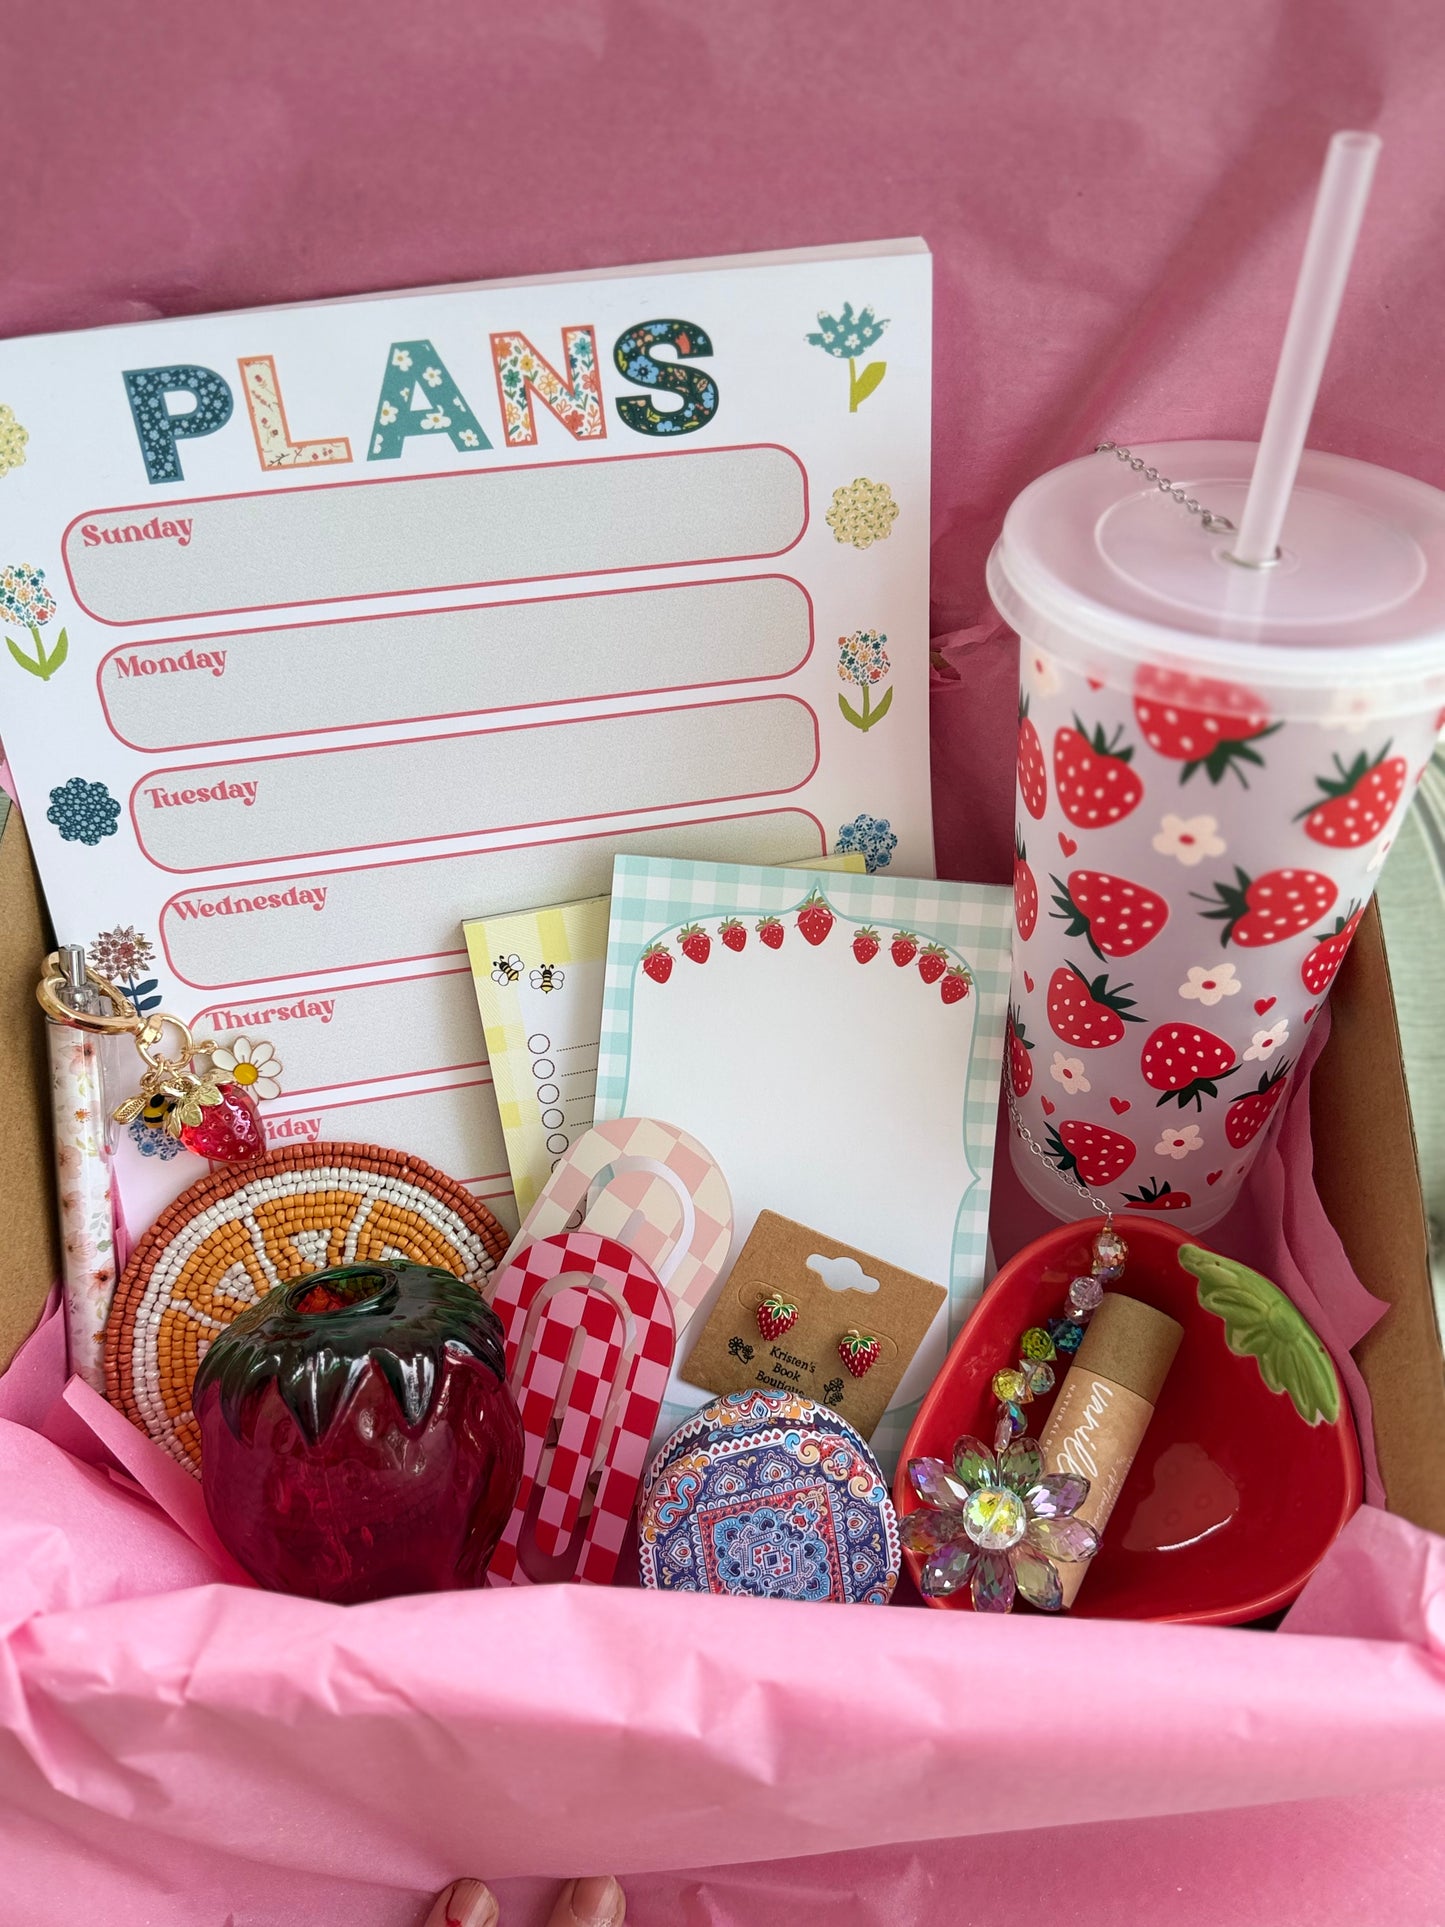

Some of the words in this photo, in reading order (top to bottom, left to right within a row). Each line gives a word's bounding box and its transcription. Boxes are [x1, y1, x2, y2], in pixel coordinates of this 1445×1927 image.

[122, 319, 719, 484] PLANS
[81, 517, 193, 547] Sunday
[114, 649, 227, 678] Monday
[144, 780, 258, 809] Tuesday
[171, 887, 328, 921] Wednesday
[205, 999, 335, 1031] Thursday
[266, 1118, 321, 1141] iday
[770, 1346, 816, 1373] Kristen's
[772, 1362, 801, 1382] Book
[1050, 1384, 1076, 1434] NATURAL
[1057, 1382, 1113, 1478] vanill
